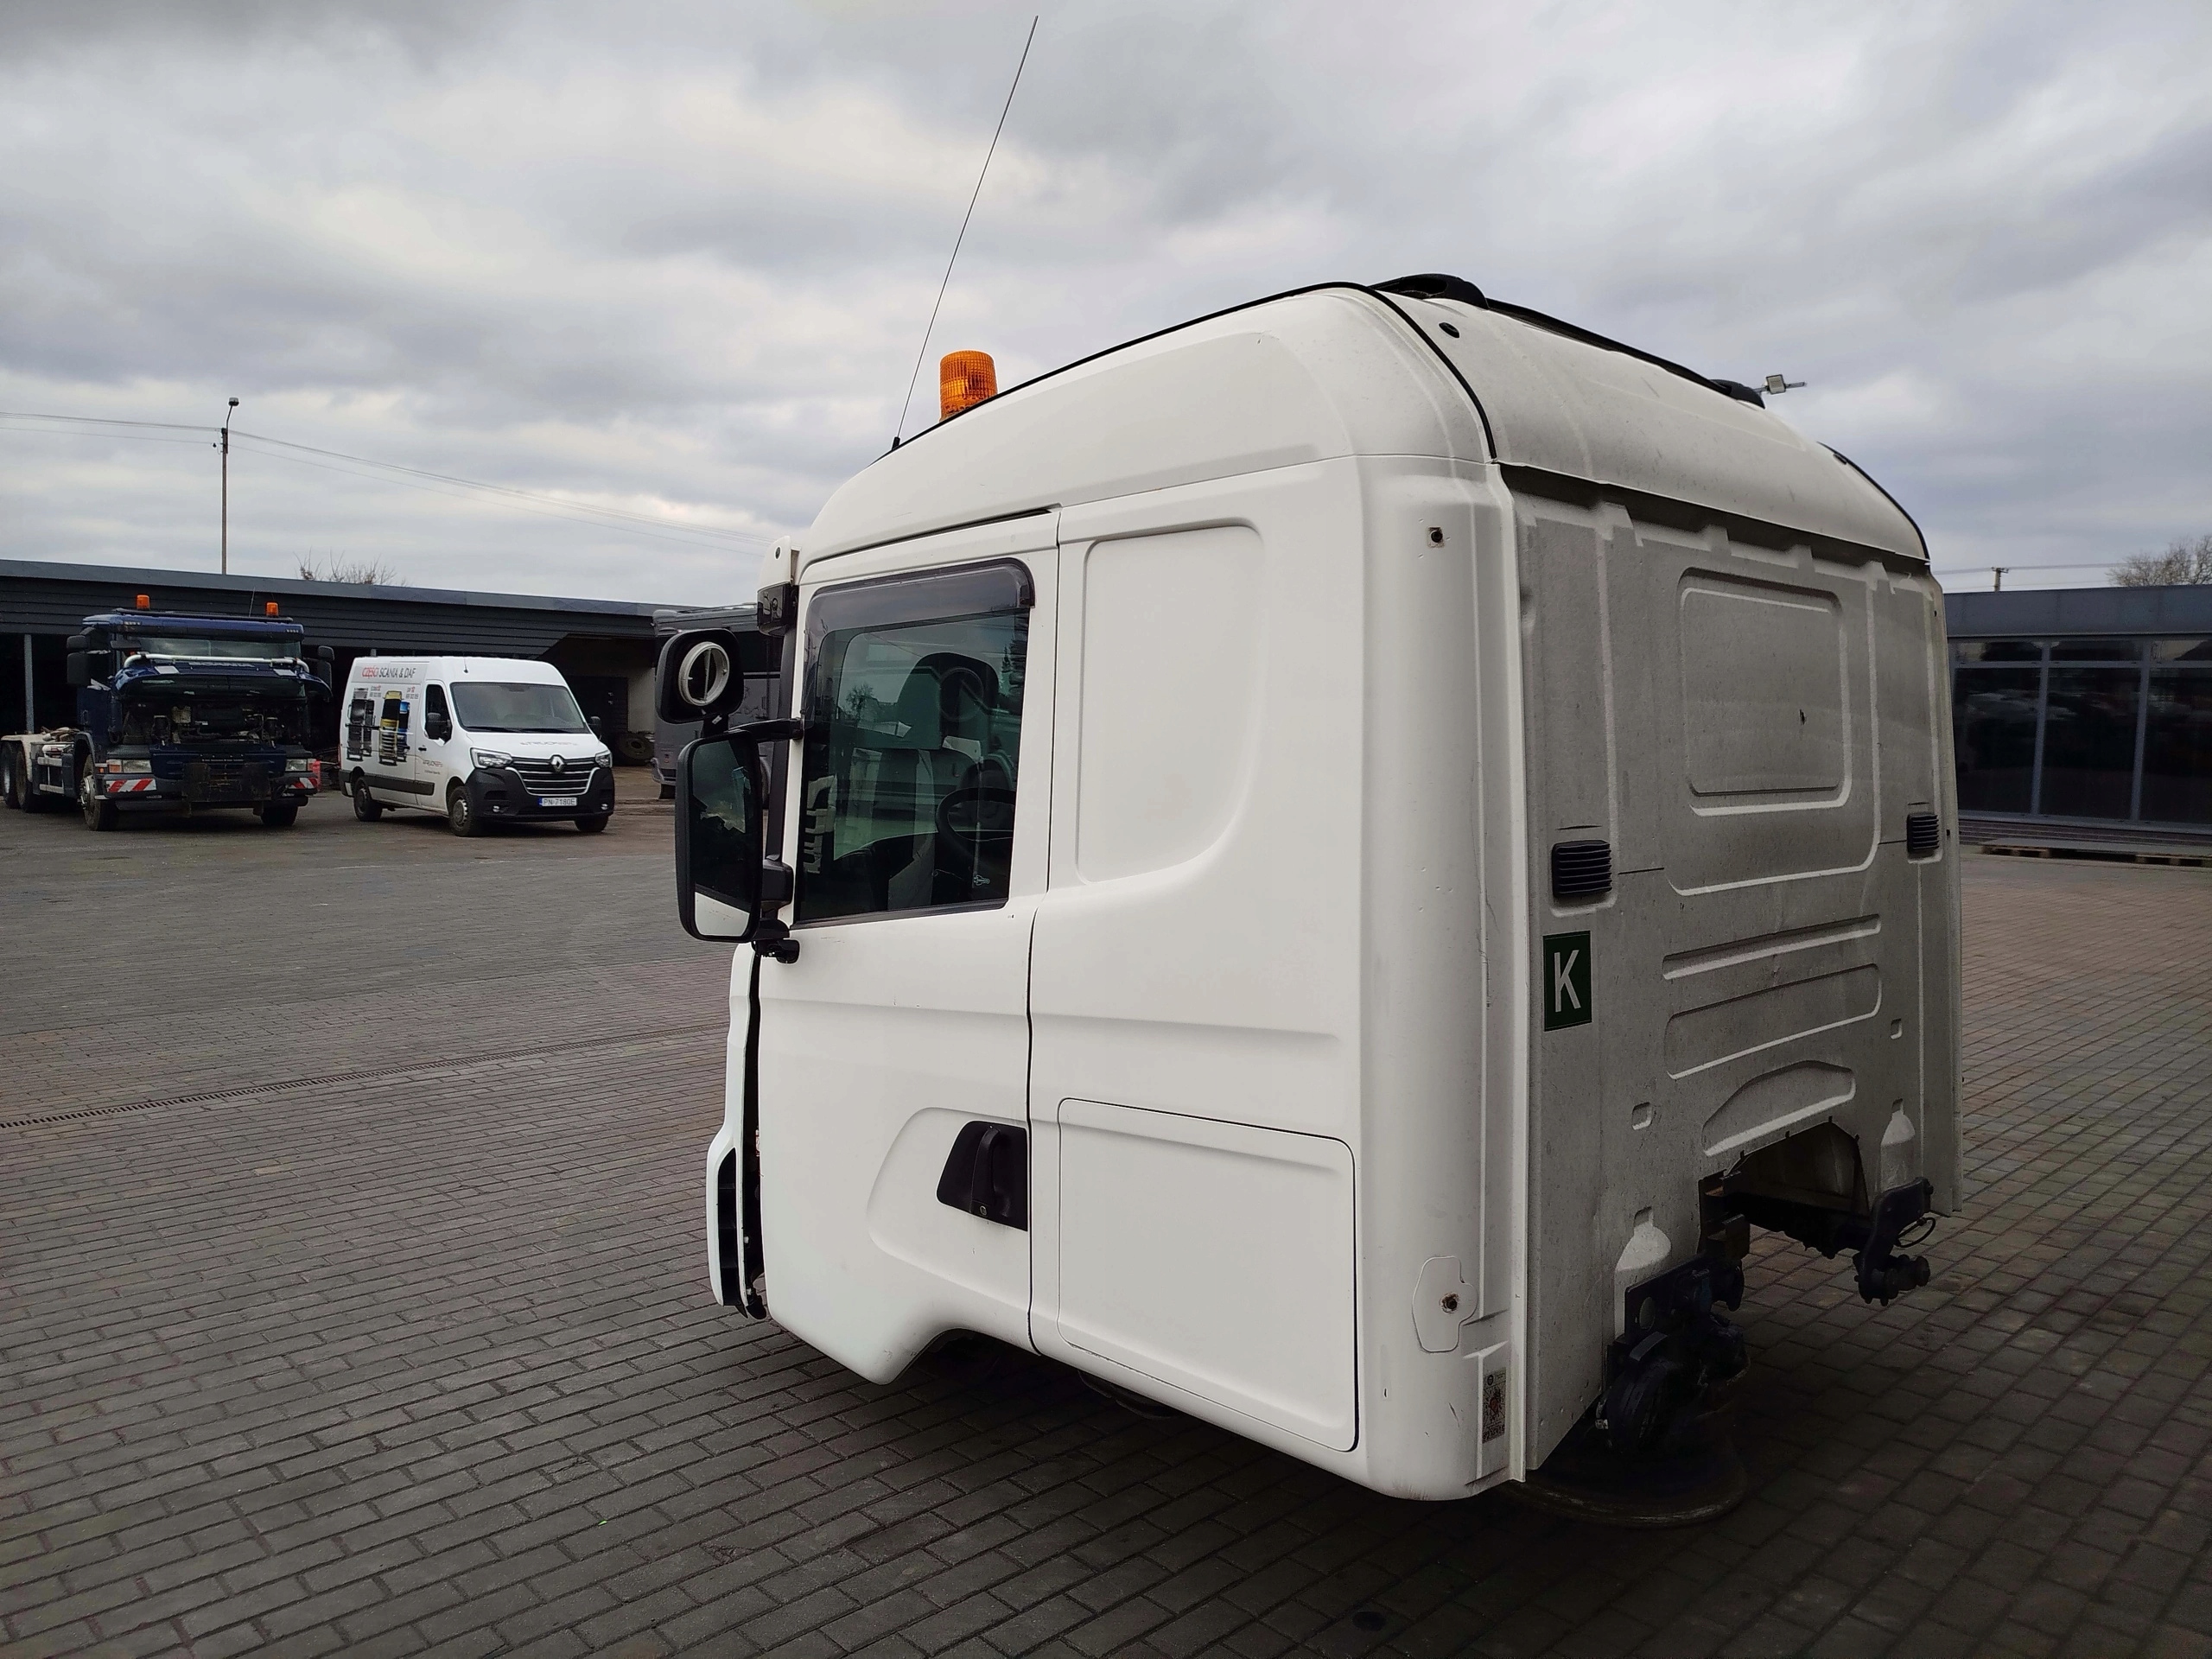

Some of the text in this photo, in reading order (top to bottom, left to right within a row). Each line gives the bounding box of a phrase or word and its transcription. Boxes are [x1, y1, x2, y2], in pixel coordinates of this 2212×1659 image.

[378, 667, 398, 678] SCANIA
[404, 668, 416, 678] DAF
[1554, 950, 1581, 1013] K
